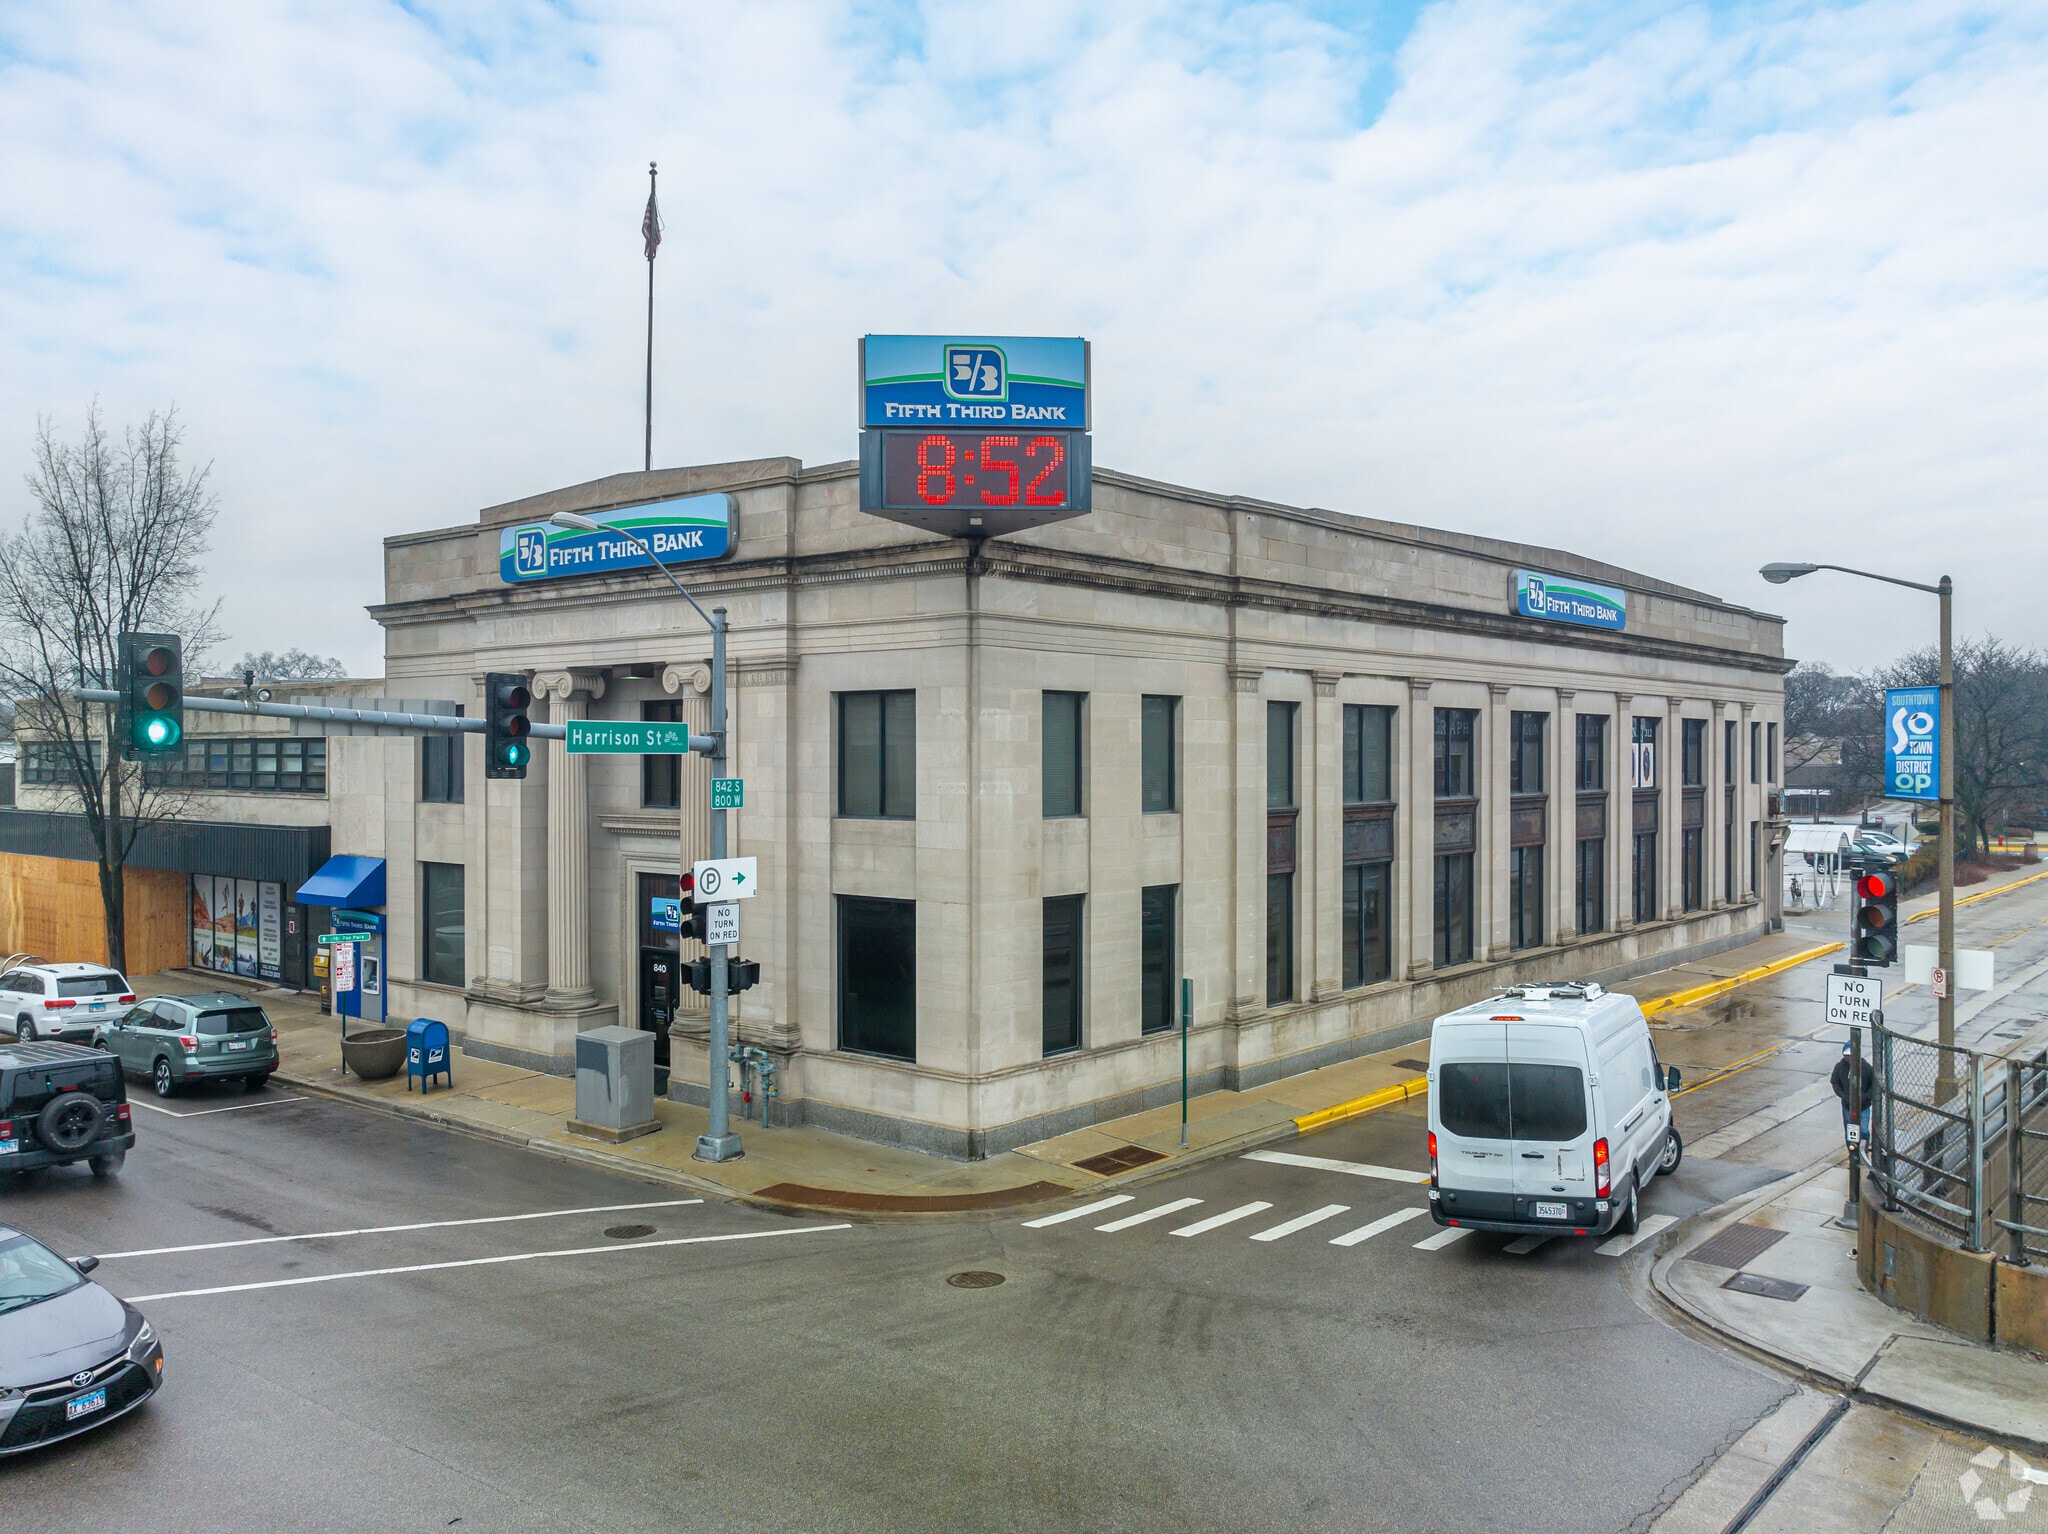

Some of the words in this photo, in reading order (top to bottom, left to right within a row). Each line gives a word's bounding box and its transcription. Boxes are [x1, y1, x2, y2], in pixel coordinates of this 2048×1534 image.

[885, 402, 941, 418] FIFTH
[947, 403, 1006, 419] THIRD
[1010, 404, 1066, 420] BANK
[917, 435, 1064, 506] 8:52
[550, 546, 593, 567] FIFTH
[598, 536, 648, 560] THIRD
[653, 530, 703, 553] BANK
[1547, 597, 1570, 614] FIFTH
[1572, 602, 1595, 618] THIRD
[1597, 606, 1617, 621] BANK
[1892, 694, 1934, 706] SOUTHTOWN
[573, 729, 639, 746] Harrison
[646, 730, 662, 746] St
[1909, 741, 1933, 754] TOWN
[1895, 761, 1932, 774] DISTRICT
[715, 781, 732, 793] 842
[734, 781, 740, 793] S
[1895, 773, 1931, 794] OP
[715, 795, 731, 807] 800
[734, 795, 741, 806] W
[718, 909, 731, 917] NO
[714, 920, 734, 929] TURN
[710, 931, 720, 940] ON
[723, 930, 738, 940] RED
[653, 964, 667, 973] 840
[1844, 982, 1865, 993] NO
[1838, 995, 1870, 1008] TURN
[1830, 1008, 1847, 1019] ON
[1852, 1011, 1869, 1022] RE
